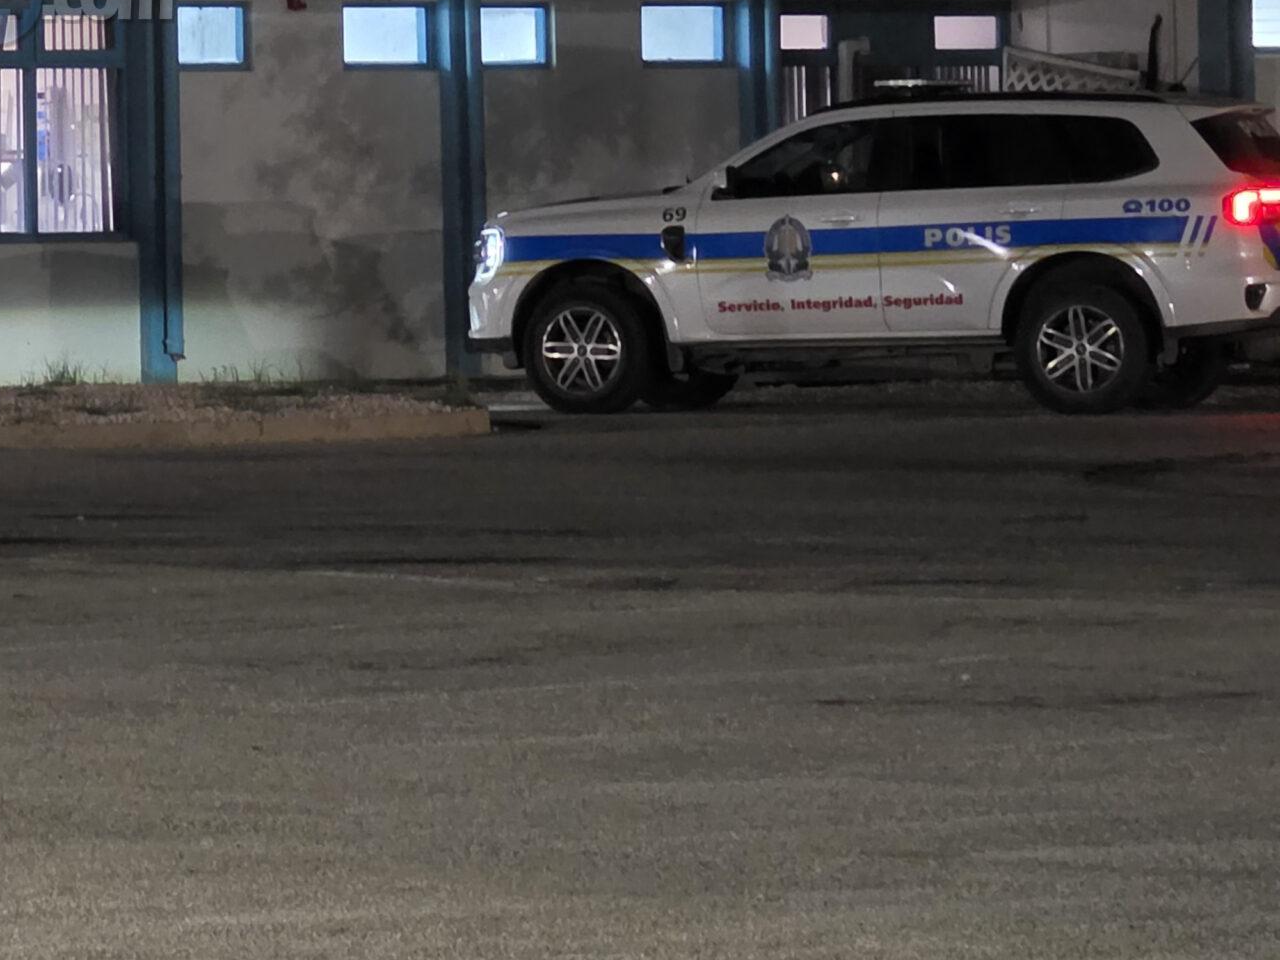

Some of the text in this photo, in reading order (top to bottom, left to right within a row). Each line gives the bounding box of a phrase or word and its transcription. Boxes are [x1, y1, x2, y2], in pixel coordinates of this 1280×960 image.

[662, 206, 687, 222] 69
[924, 225, 1012, 247] POLIS
[882, 293, 963, 309] Seguridad
